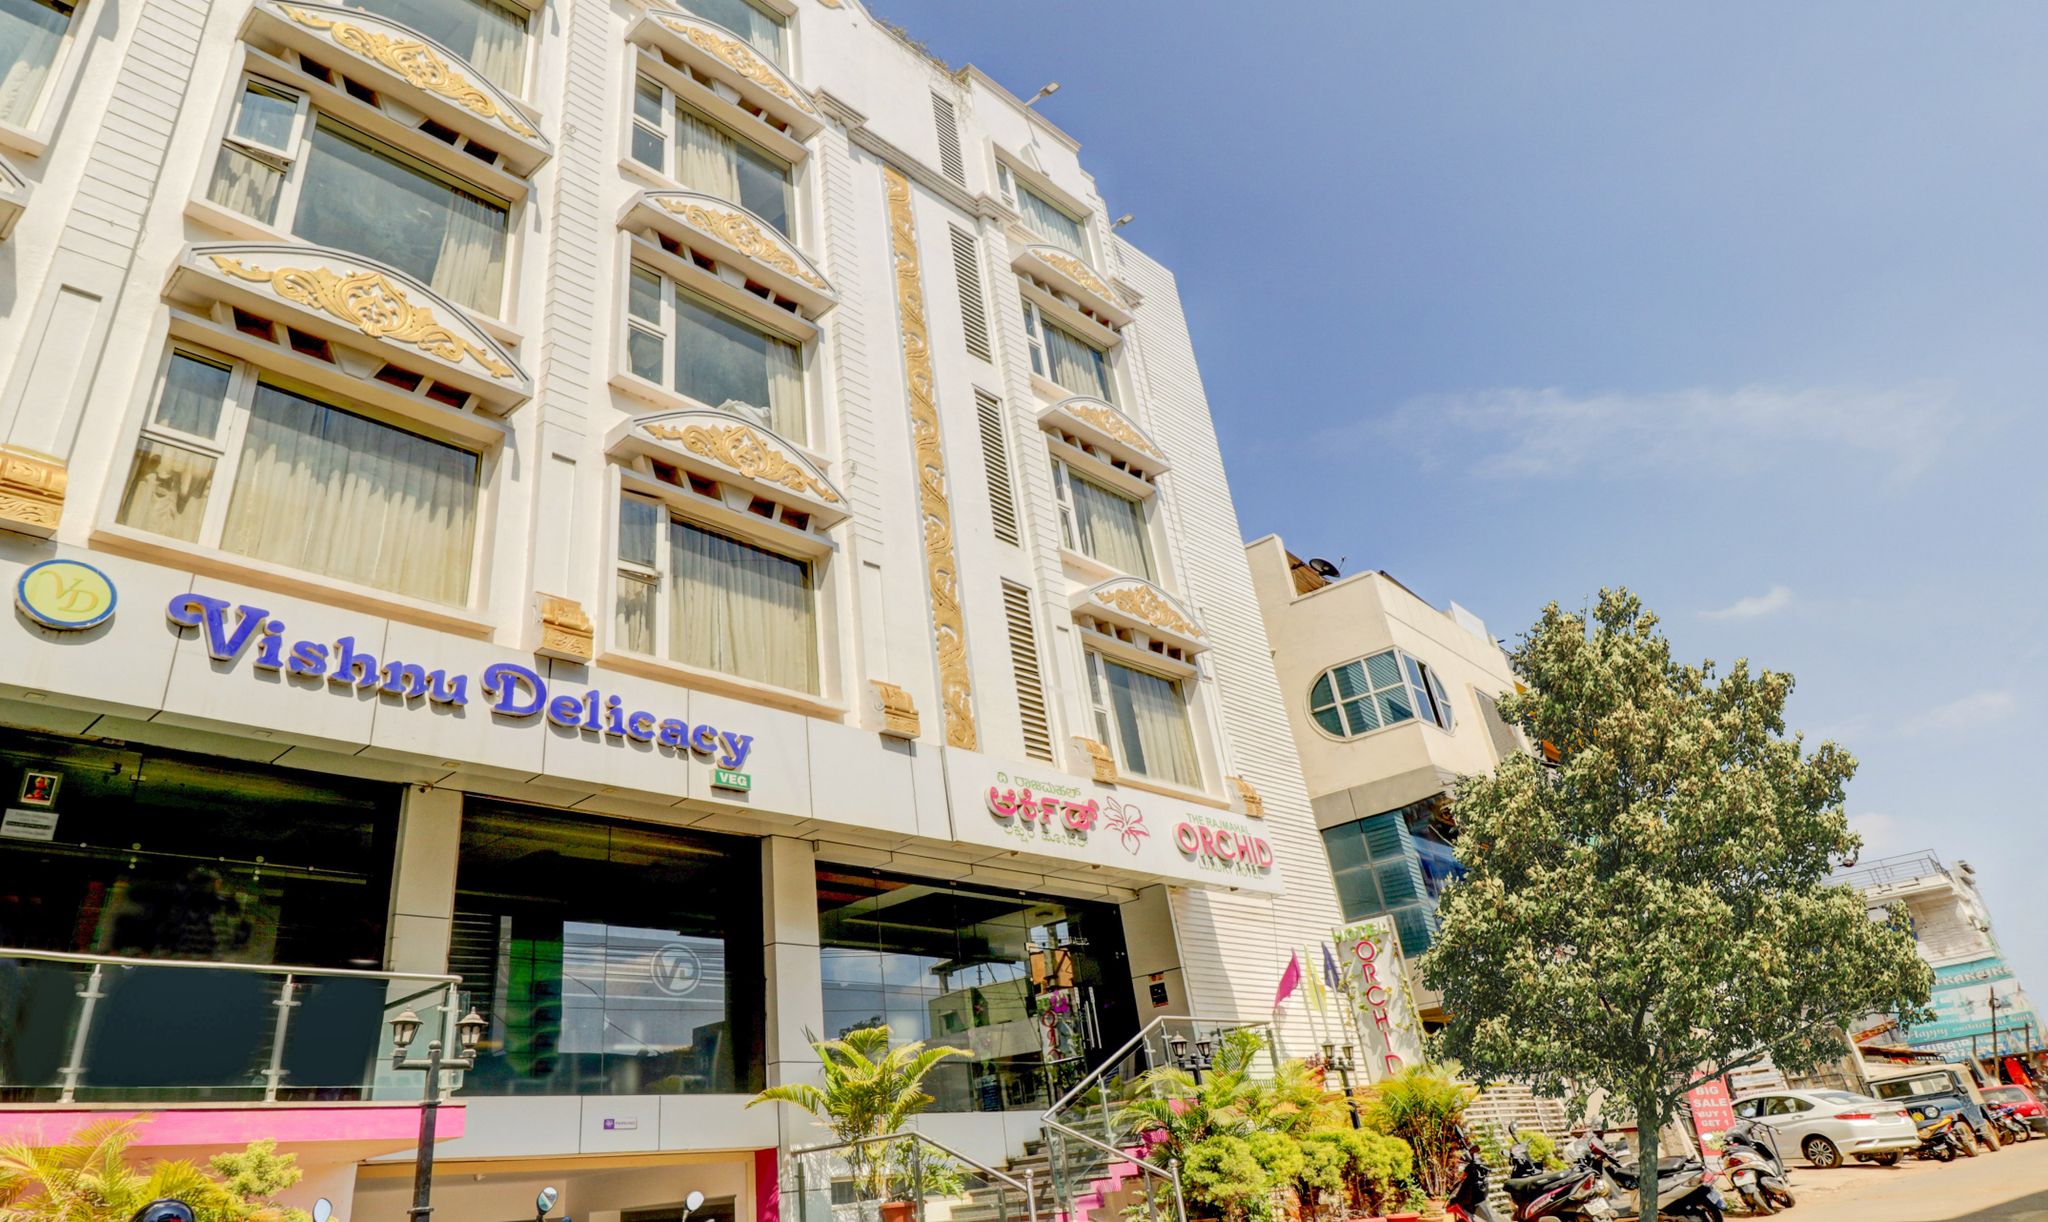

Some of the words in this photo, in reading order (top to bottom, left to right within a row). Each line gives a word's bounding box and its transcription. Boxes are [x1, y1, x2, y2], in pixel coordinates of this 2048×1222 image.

[166, 593, 468, 705] Vishnu
[481, 663, 753, 769] Delicacy
[719, 772, 747, 786] VEG
[1186, 812, 1204, 824] THE
[1173, 822, 1273, 867] ORCHID
[1198, 857, 1233, 874] LUXURY
[1236, 863, 1264, 880] HOTEL
[1334, 921, 1390, 943] HOTEL
[1696, 1086, 1719, 1095] BIG
[1694, 1098, 1726, 1107] SALE
[1701, 1119, 1720, 1127] GET
